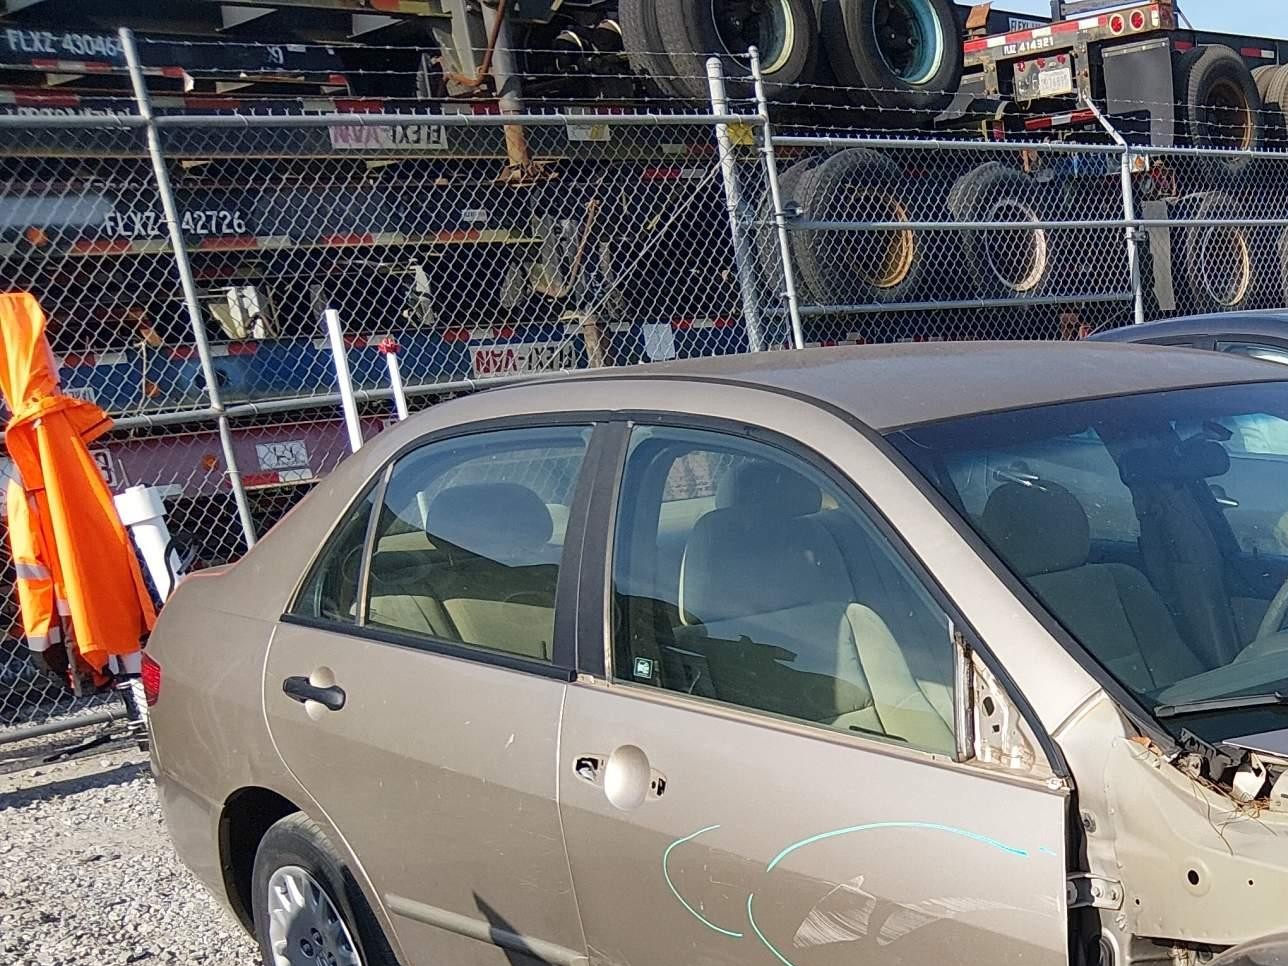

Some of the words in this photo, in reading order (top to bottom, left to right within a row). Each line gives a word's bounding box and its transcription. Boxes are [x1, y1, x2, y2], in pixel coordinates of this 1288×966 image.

[6, 28, 57, 53] FLXZ
[105, 211, 161, 236] FLXZ
[181, 210, 247, 234] 42726
[475, 345, 573, 373] FLEXI-VAN
